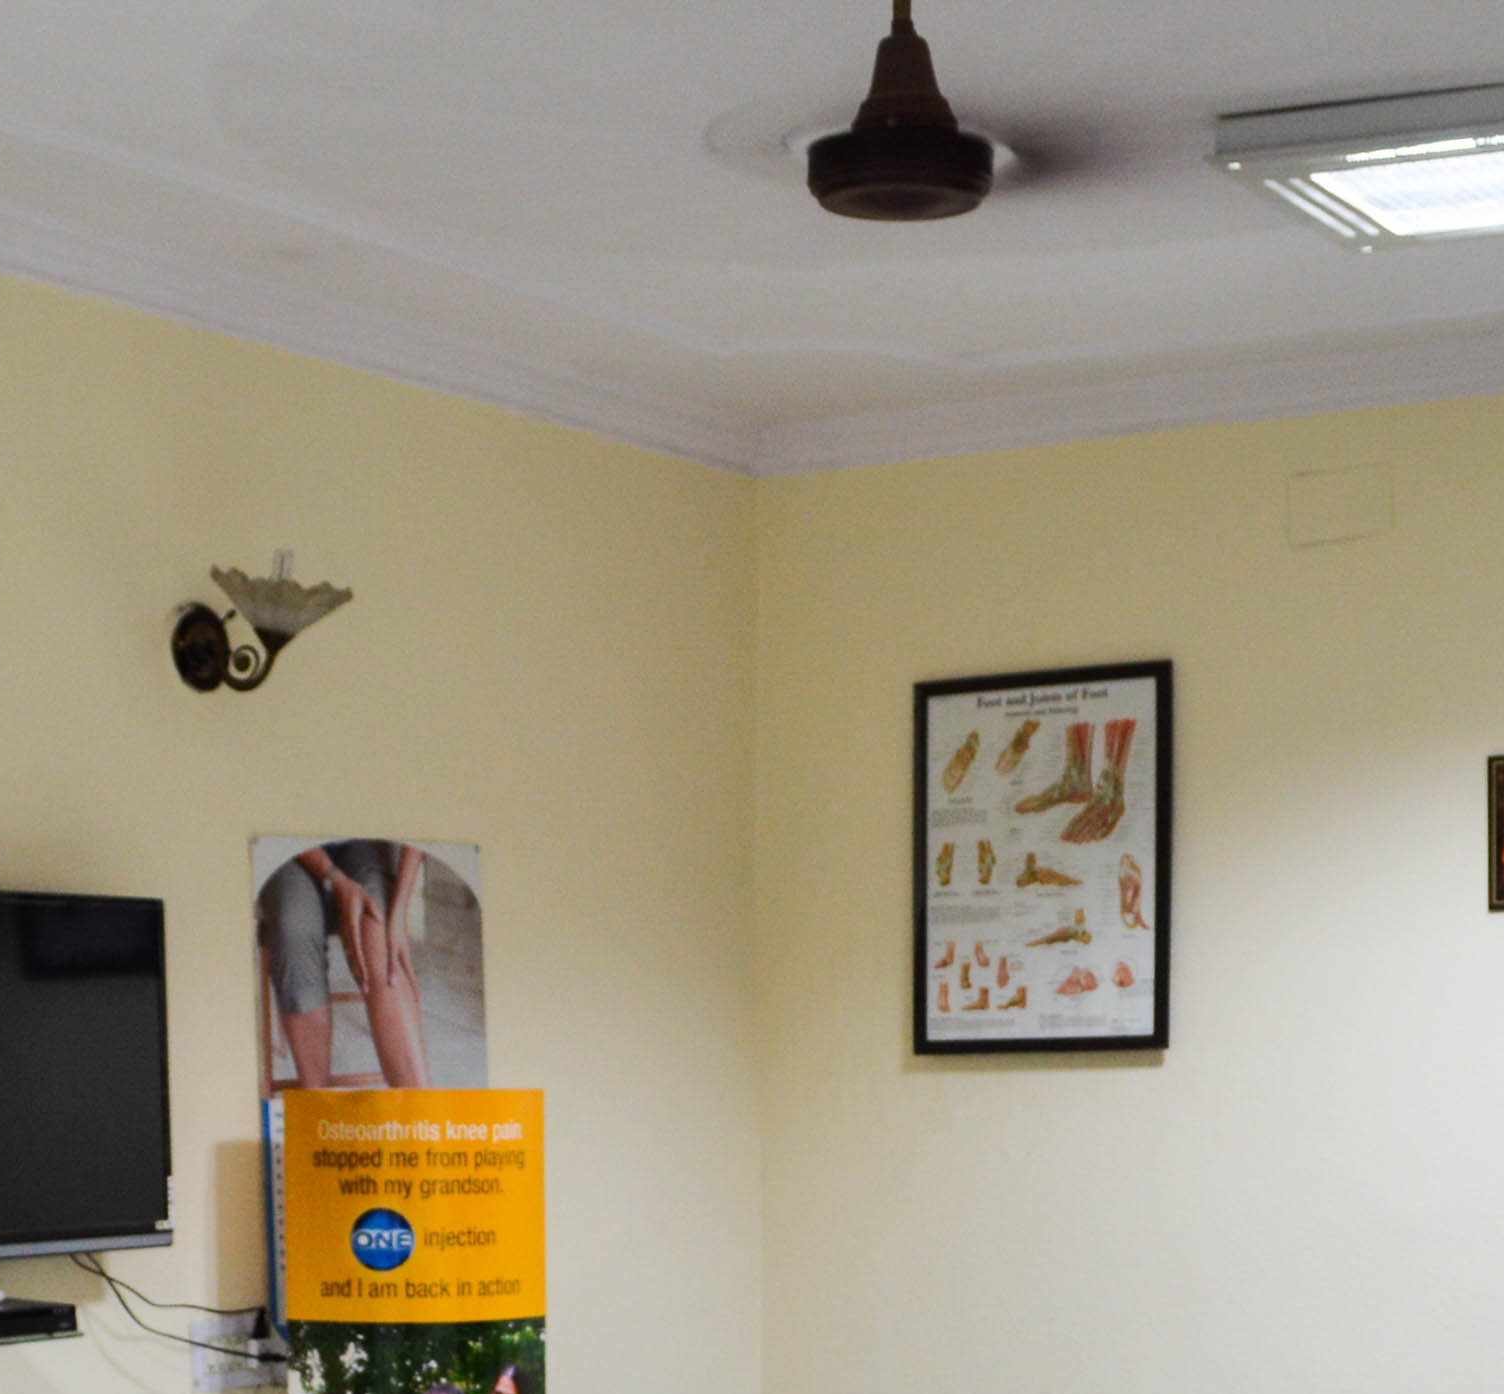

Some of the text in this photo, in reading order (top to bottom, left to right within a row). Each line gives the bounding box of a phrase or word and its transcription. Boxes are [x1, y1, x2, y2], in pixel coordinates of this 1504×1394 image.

[317, 1119, 523, 1144] Osteoarthritis knee pain
[313, 1147, 525, 1171] stopped me from playing
[339, 1175, 378, 1195] with
[384, 1178, 412, 1199] my
[353, 1228, 497, 1251] ONE injection
[320, 1277, 521, 1299] and I am back in action
